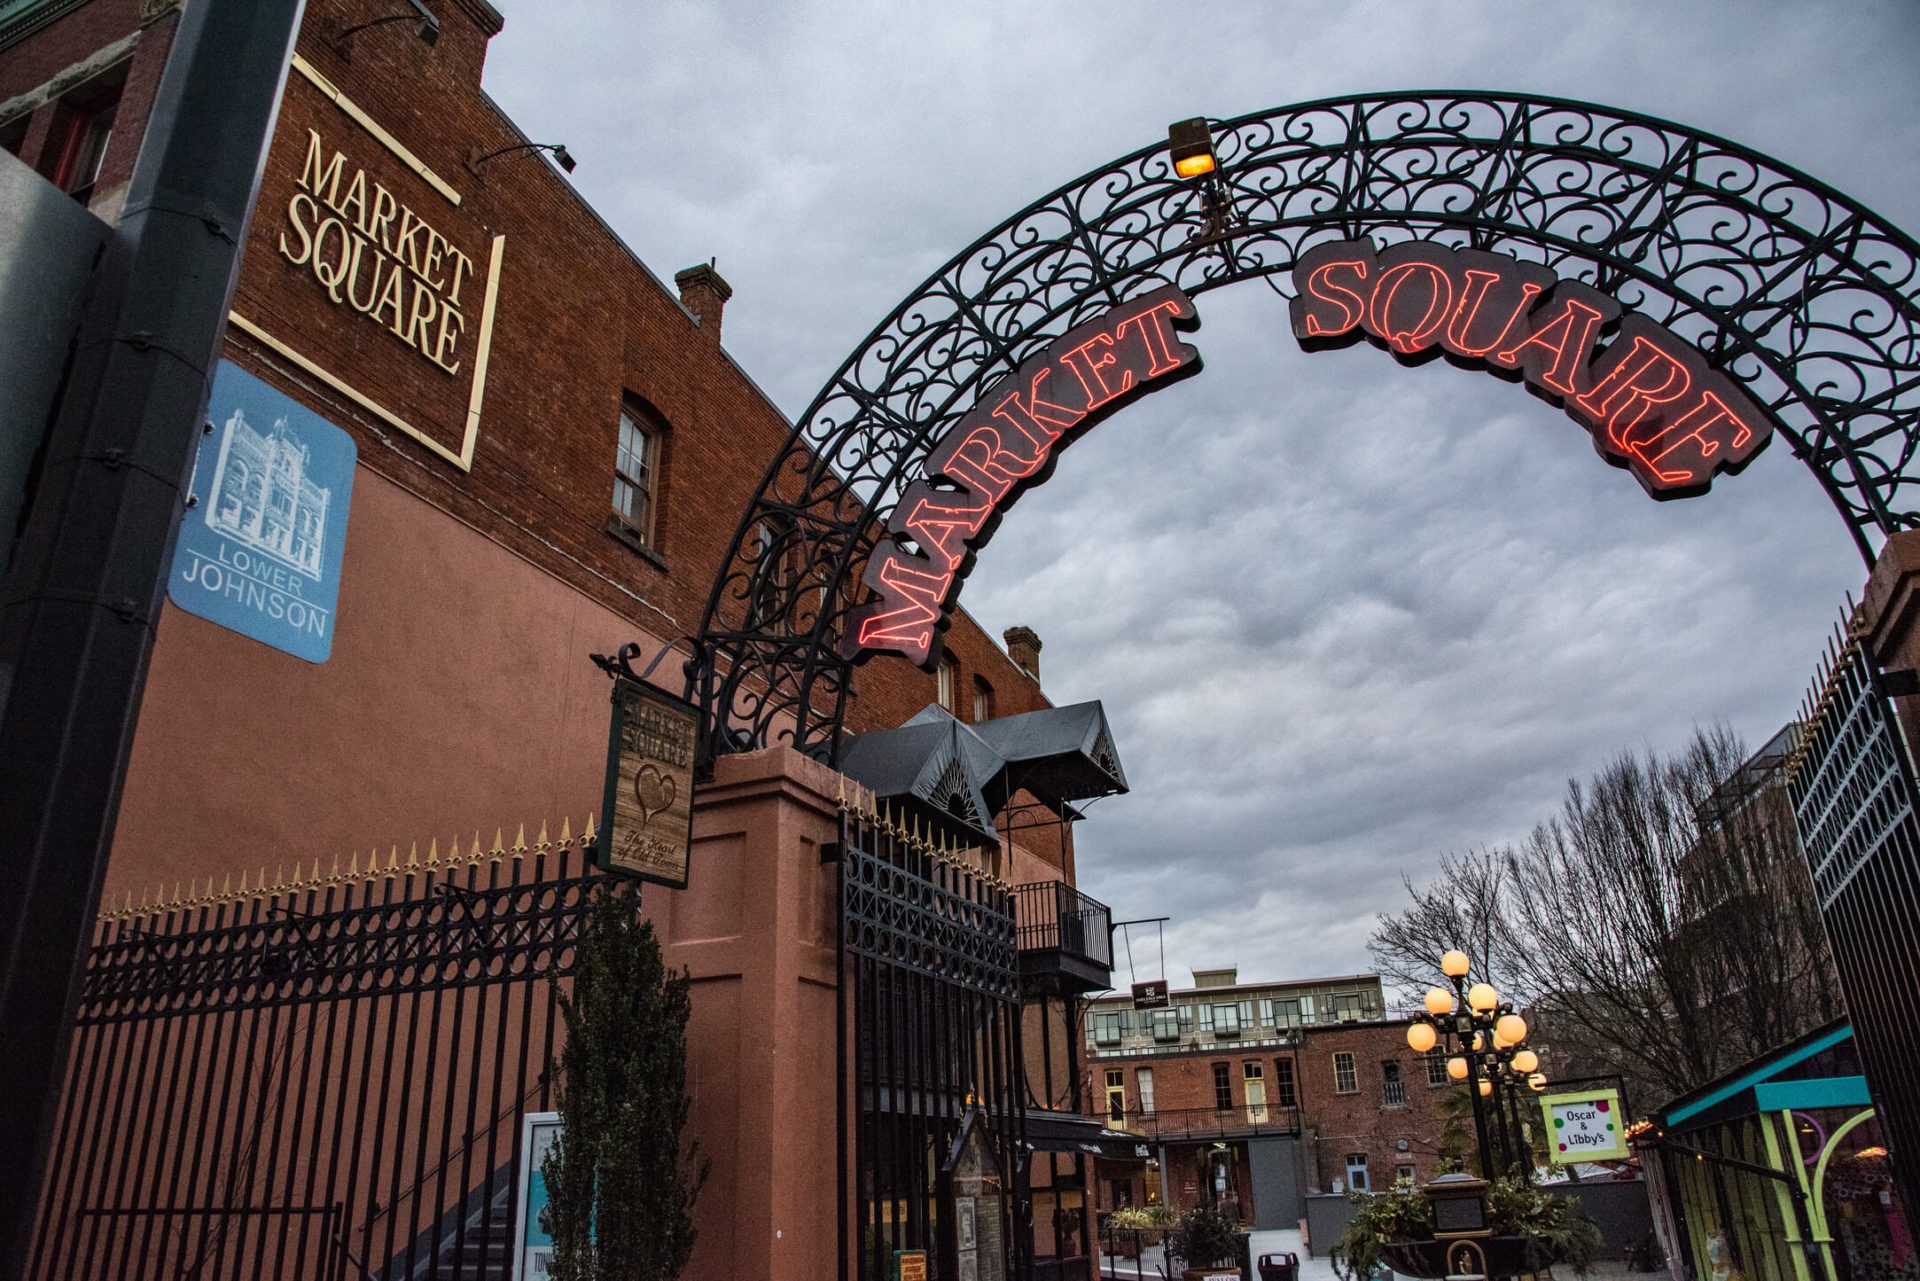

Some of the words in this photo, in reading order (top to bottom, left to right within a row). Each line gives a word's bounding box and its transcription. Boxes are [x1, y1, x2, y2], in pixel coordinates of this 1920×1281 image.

[296, 128, 474, 307] MARKET
[279, 193, 466, 376] SQUARE
[858, 300, 1183, 650] MARKET
[1305, 260, 1753, 483] SQUARE
[218, 543, 303, 595] LOWER
[182, 557, 327, 638] JOHNSON
[631, 701, 693, 742] MARKET
[628, 727, 688, 768] SQUARE
[618, 845, 632, 861] of
[632, 847, 651, 861] Old
[653, 852, 679, 869] Town
[624, 830, 645, 846] The
[647, 836, 677, 855] Heart
[1566, 1110, 1596, 1121] Oscar
[1580, 1121, 1588, 1131] &
[1567, 1132, 1605, 1146] Libby's
